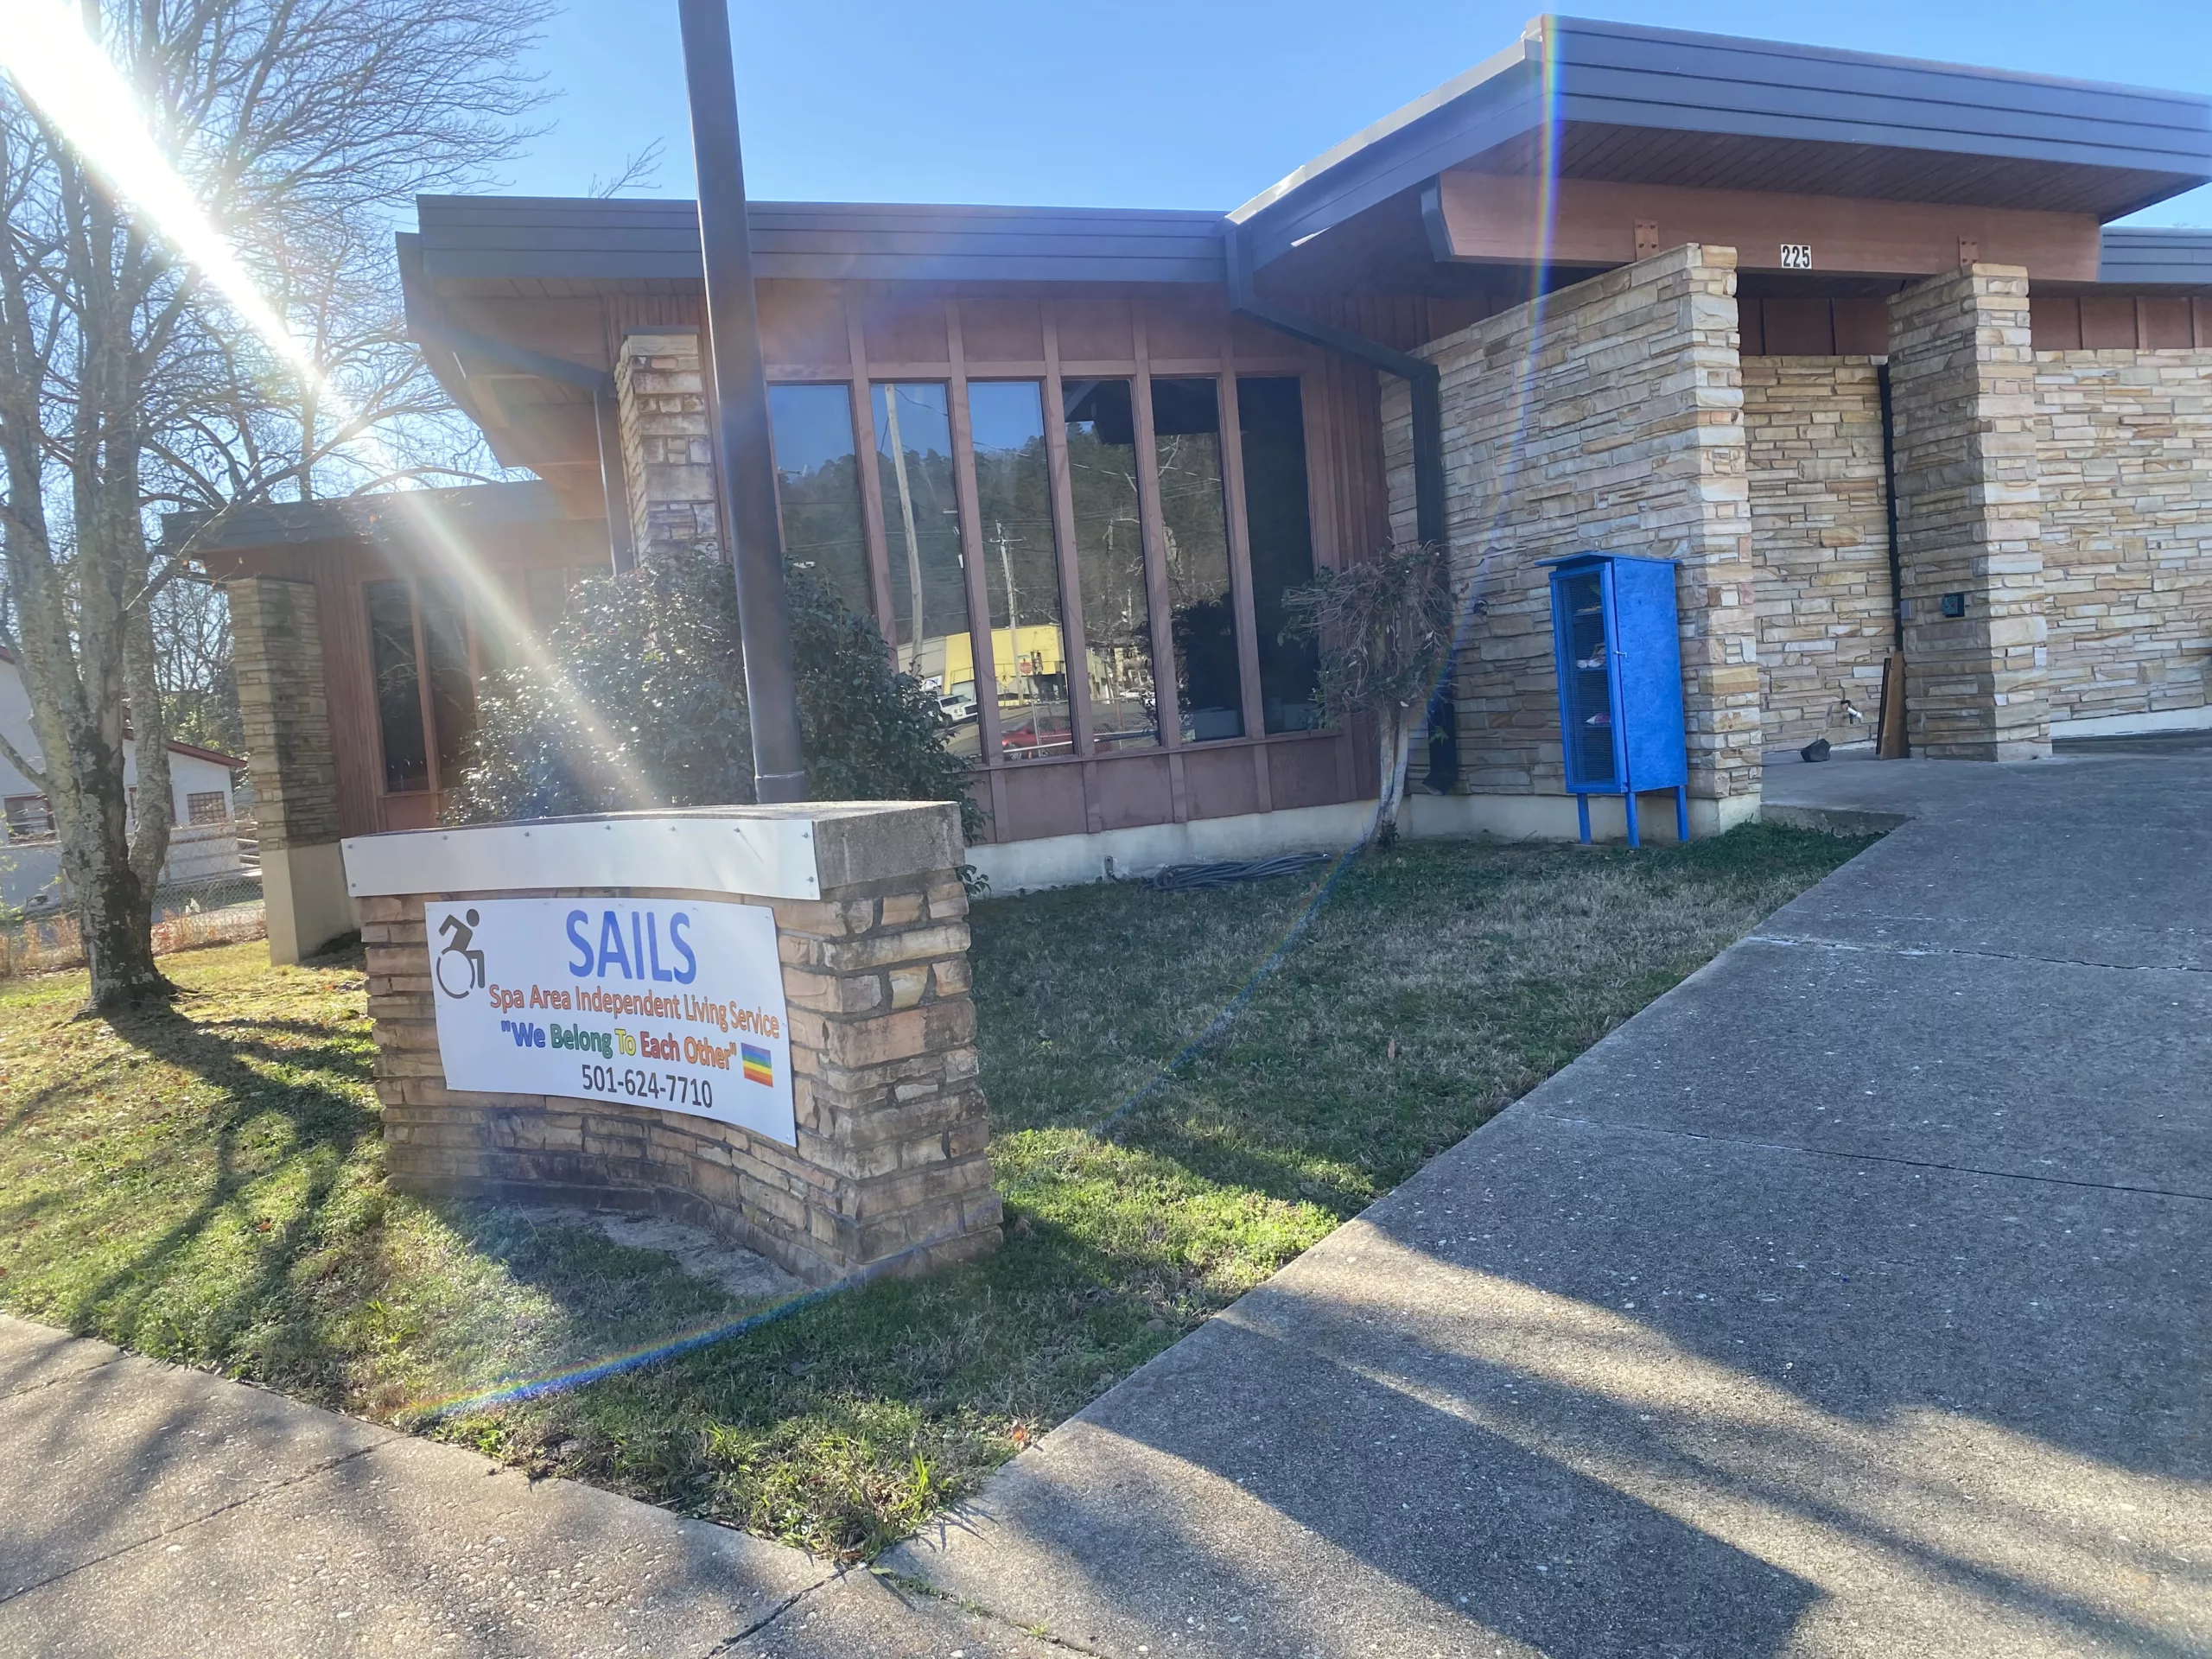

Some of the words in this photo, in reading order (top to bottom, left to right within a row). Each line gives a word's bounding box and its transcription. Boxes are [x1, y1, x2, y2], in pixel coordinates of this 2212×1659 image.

[1782, 245, 1810, 267] 225
[566, 910, 696, 984] SAILS
[489, 984, 524, 1014] Spa
[530, 984, 571, 1009] Area
[575, 986, 681, 1020] Independent
[683, 995, 728, 1033] Living
[729, 1001, 779, 1039] Service
[501, 1020, 545, 1047] "We
[550, 1024, 613, 1058] Belong
[614, 1028, 636, 1056] To
[640, 1031, 680, 1062] Each
[683, 1036, 737, 1071] Other"
[582, 1065, 713, 1109] 501-624-7710
